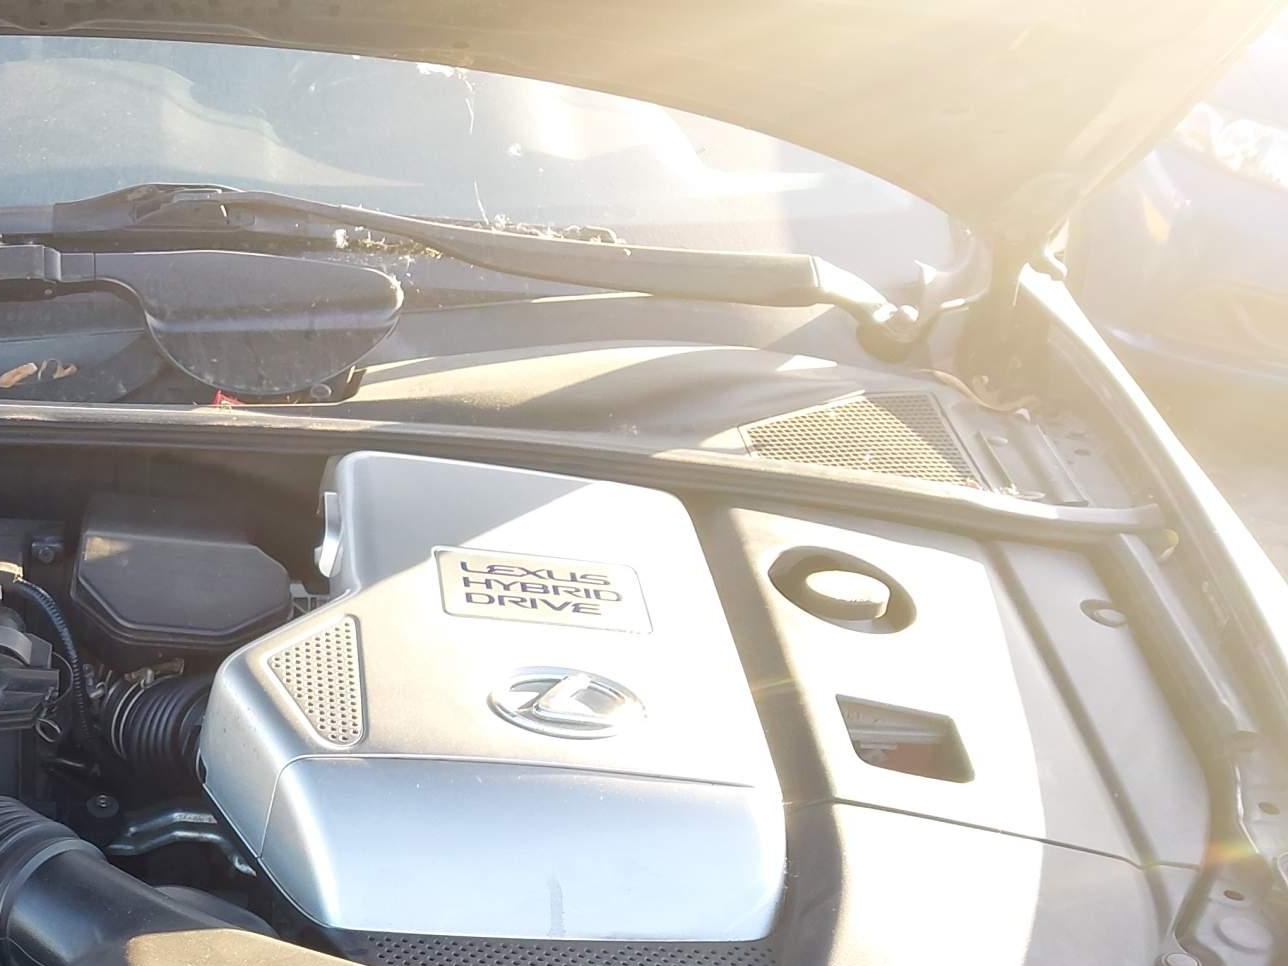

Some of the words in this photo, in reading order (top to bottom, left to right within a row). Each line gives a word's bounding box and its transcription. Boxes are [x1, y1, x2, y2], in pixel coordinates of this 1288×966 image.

[460, 561, 611, 586] LEXUS
[462, 576, 623, 602] HYBRID
[465, 592, 602, 615] DRIVE
